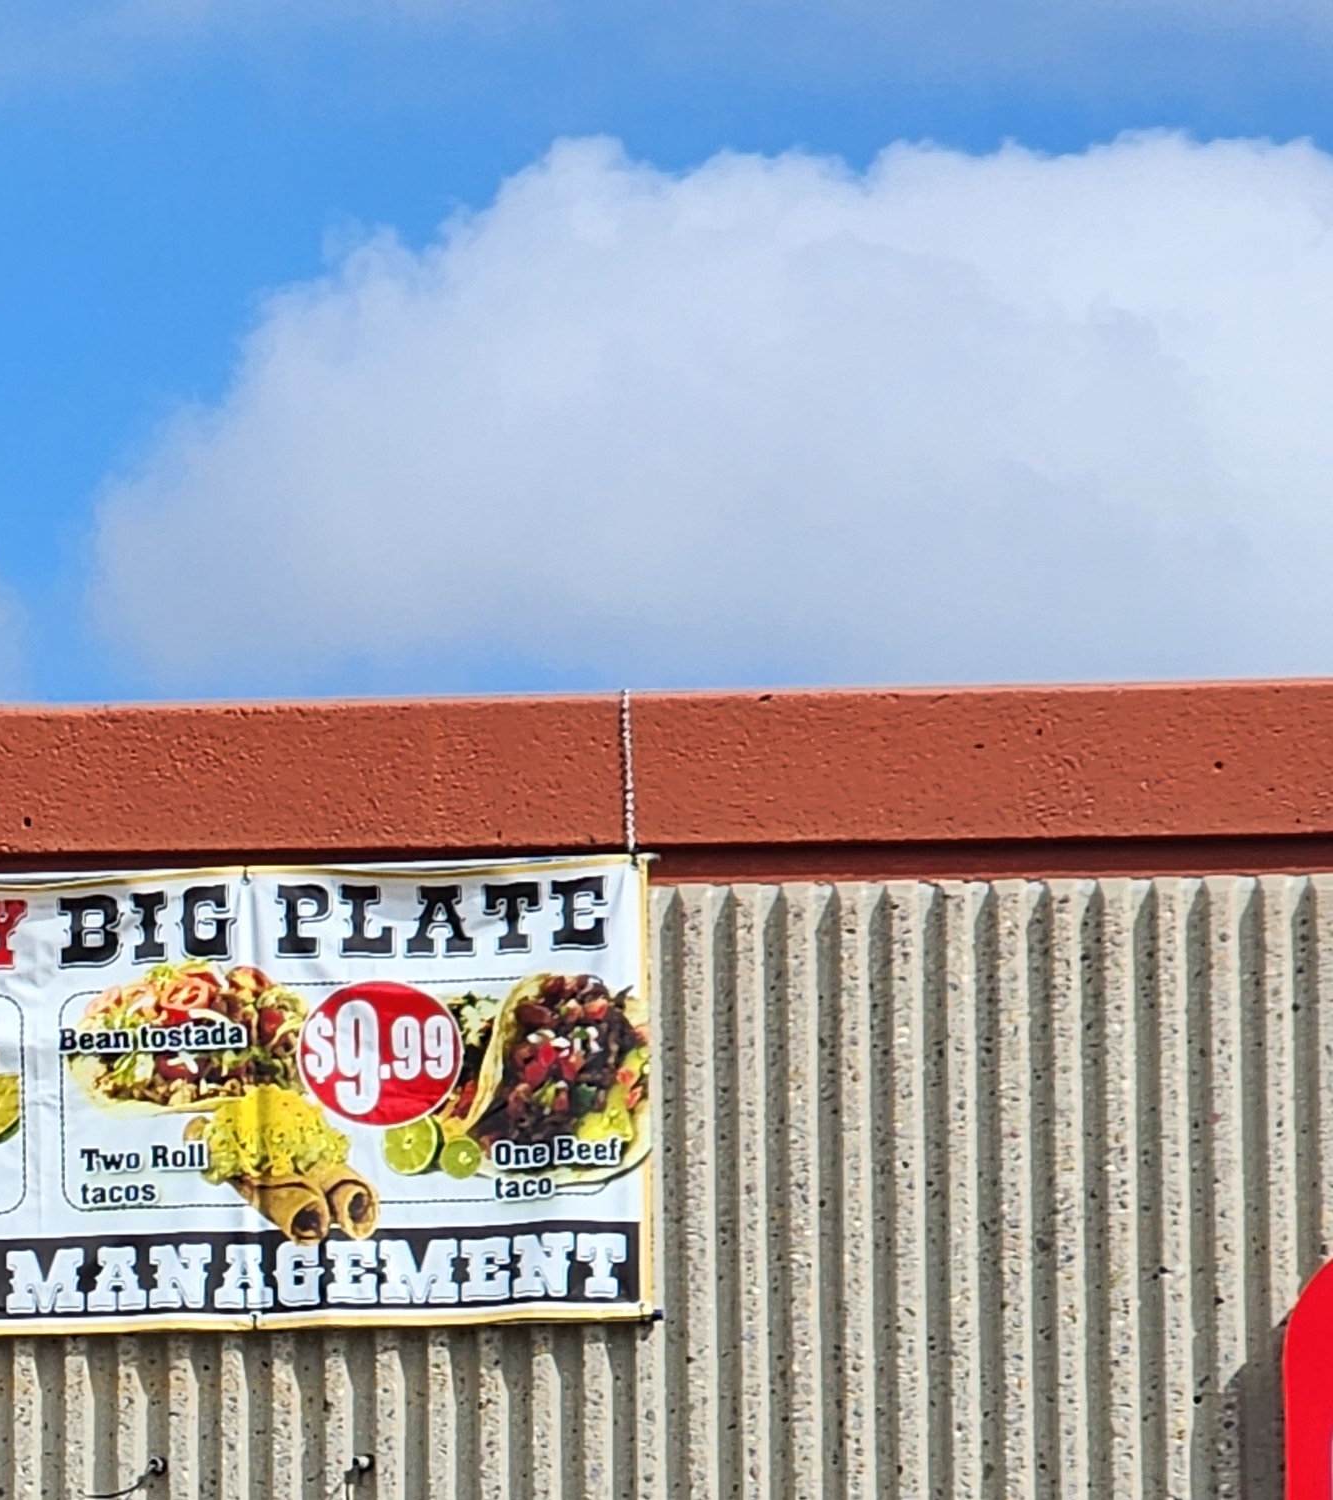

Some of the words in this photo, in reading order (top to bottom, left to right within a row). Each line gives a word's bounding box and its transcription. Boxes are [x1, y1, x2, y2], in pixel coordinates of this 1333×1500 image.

[58, 883, 233, 968] BIG
[274, 875, 609, 959] PLATE
[59, 1027, 131, 1053] Bean
[138, 1022, 246, 1049] tostada
[304, 999, 455, 1116] $9.99
[80, 1148, 141, 1173] Two
[150, 1145, 208, 1170] Roll
[494, 1141, 551, 1167] One
[555, 1136, 624, 1165] Beef
[80, 1180, 156, 1203] tacos
[494, 1175, 553, 1200] taco
[4, 1232, 628, 1316] MANAGEMENT
